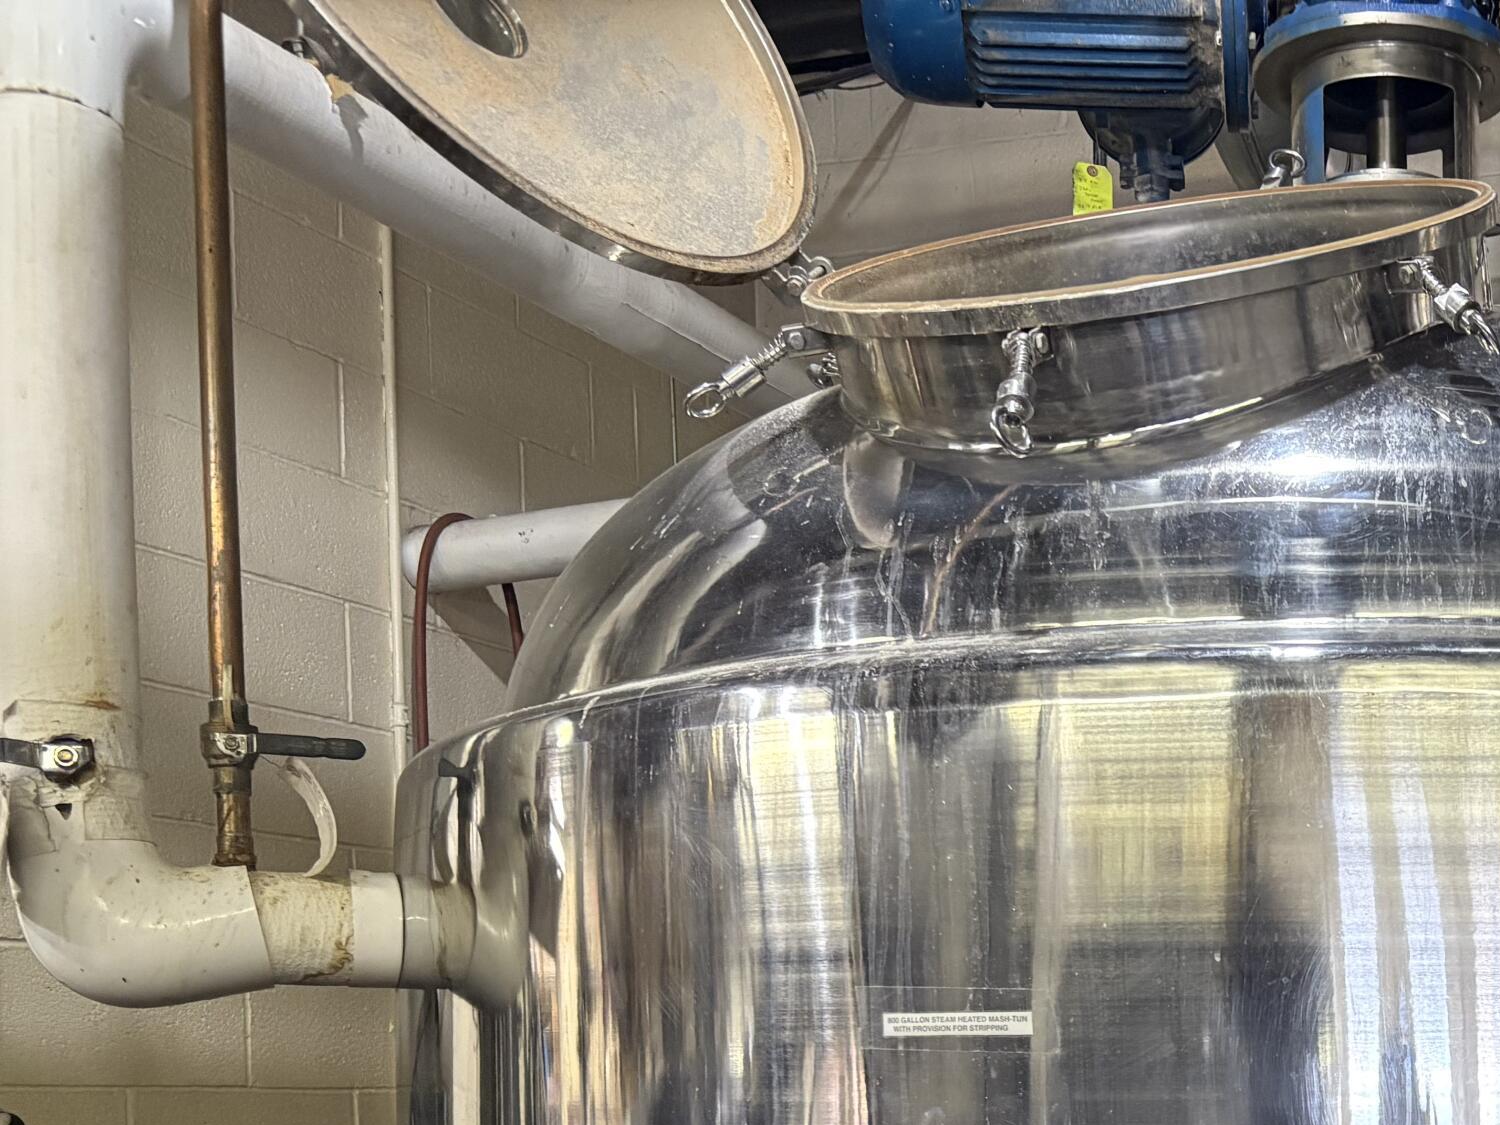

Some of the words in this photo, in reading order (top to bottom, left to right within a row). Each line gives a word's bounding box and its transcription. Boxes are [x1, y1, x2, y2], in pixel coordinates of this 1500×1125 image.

[901, 1016, 930, 1024] GALLON
[931, 1015, 956, 1023] STEAM
[957, 1015, 987, 1023] HEATED
[988, 1015, 1028, 1023] MASH-TUN
[893, 1025, 911, 1033] WITH
[912, 1025, 951, 1033] PROVISION
[952, 1024, 968, 1032] FOR
[969, 1024, 1008, 1032] STRIPPING
